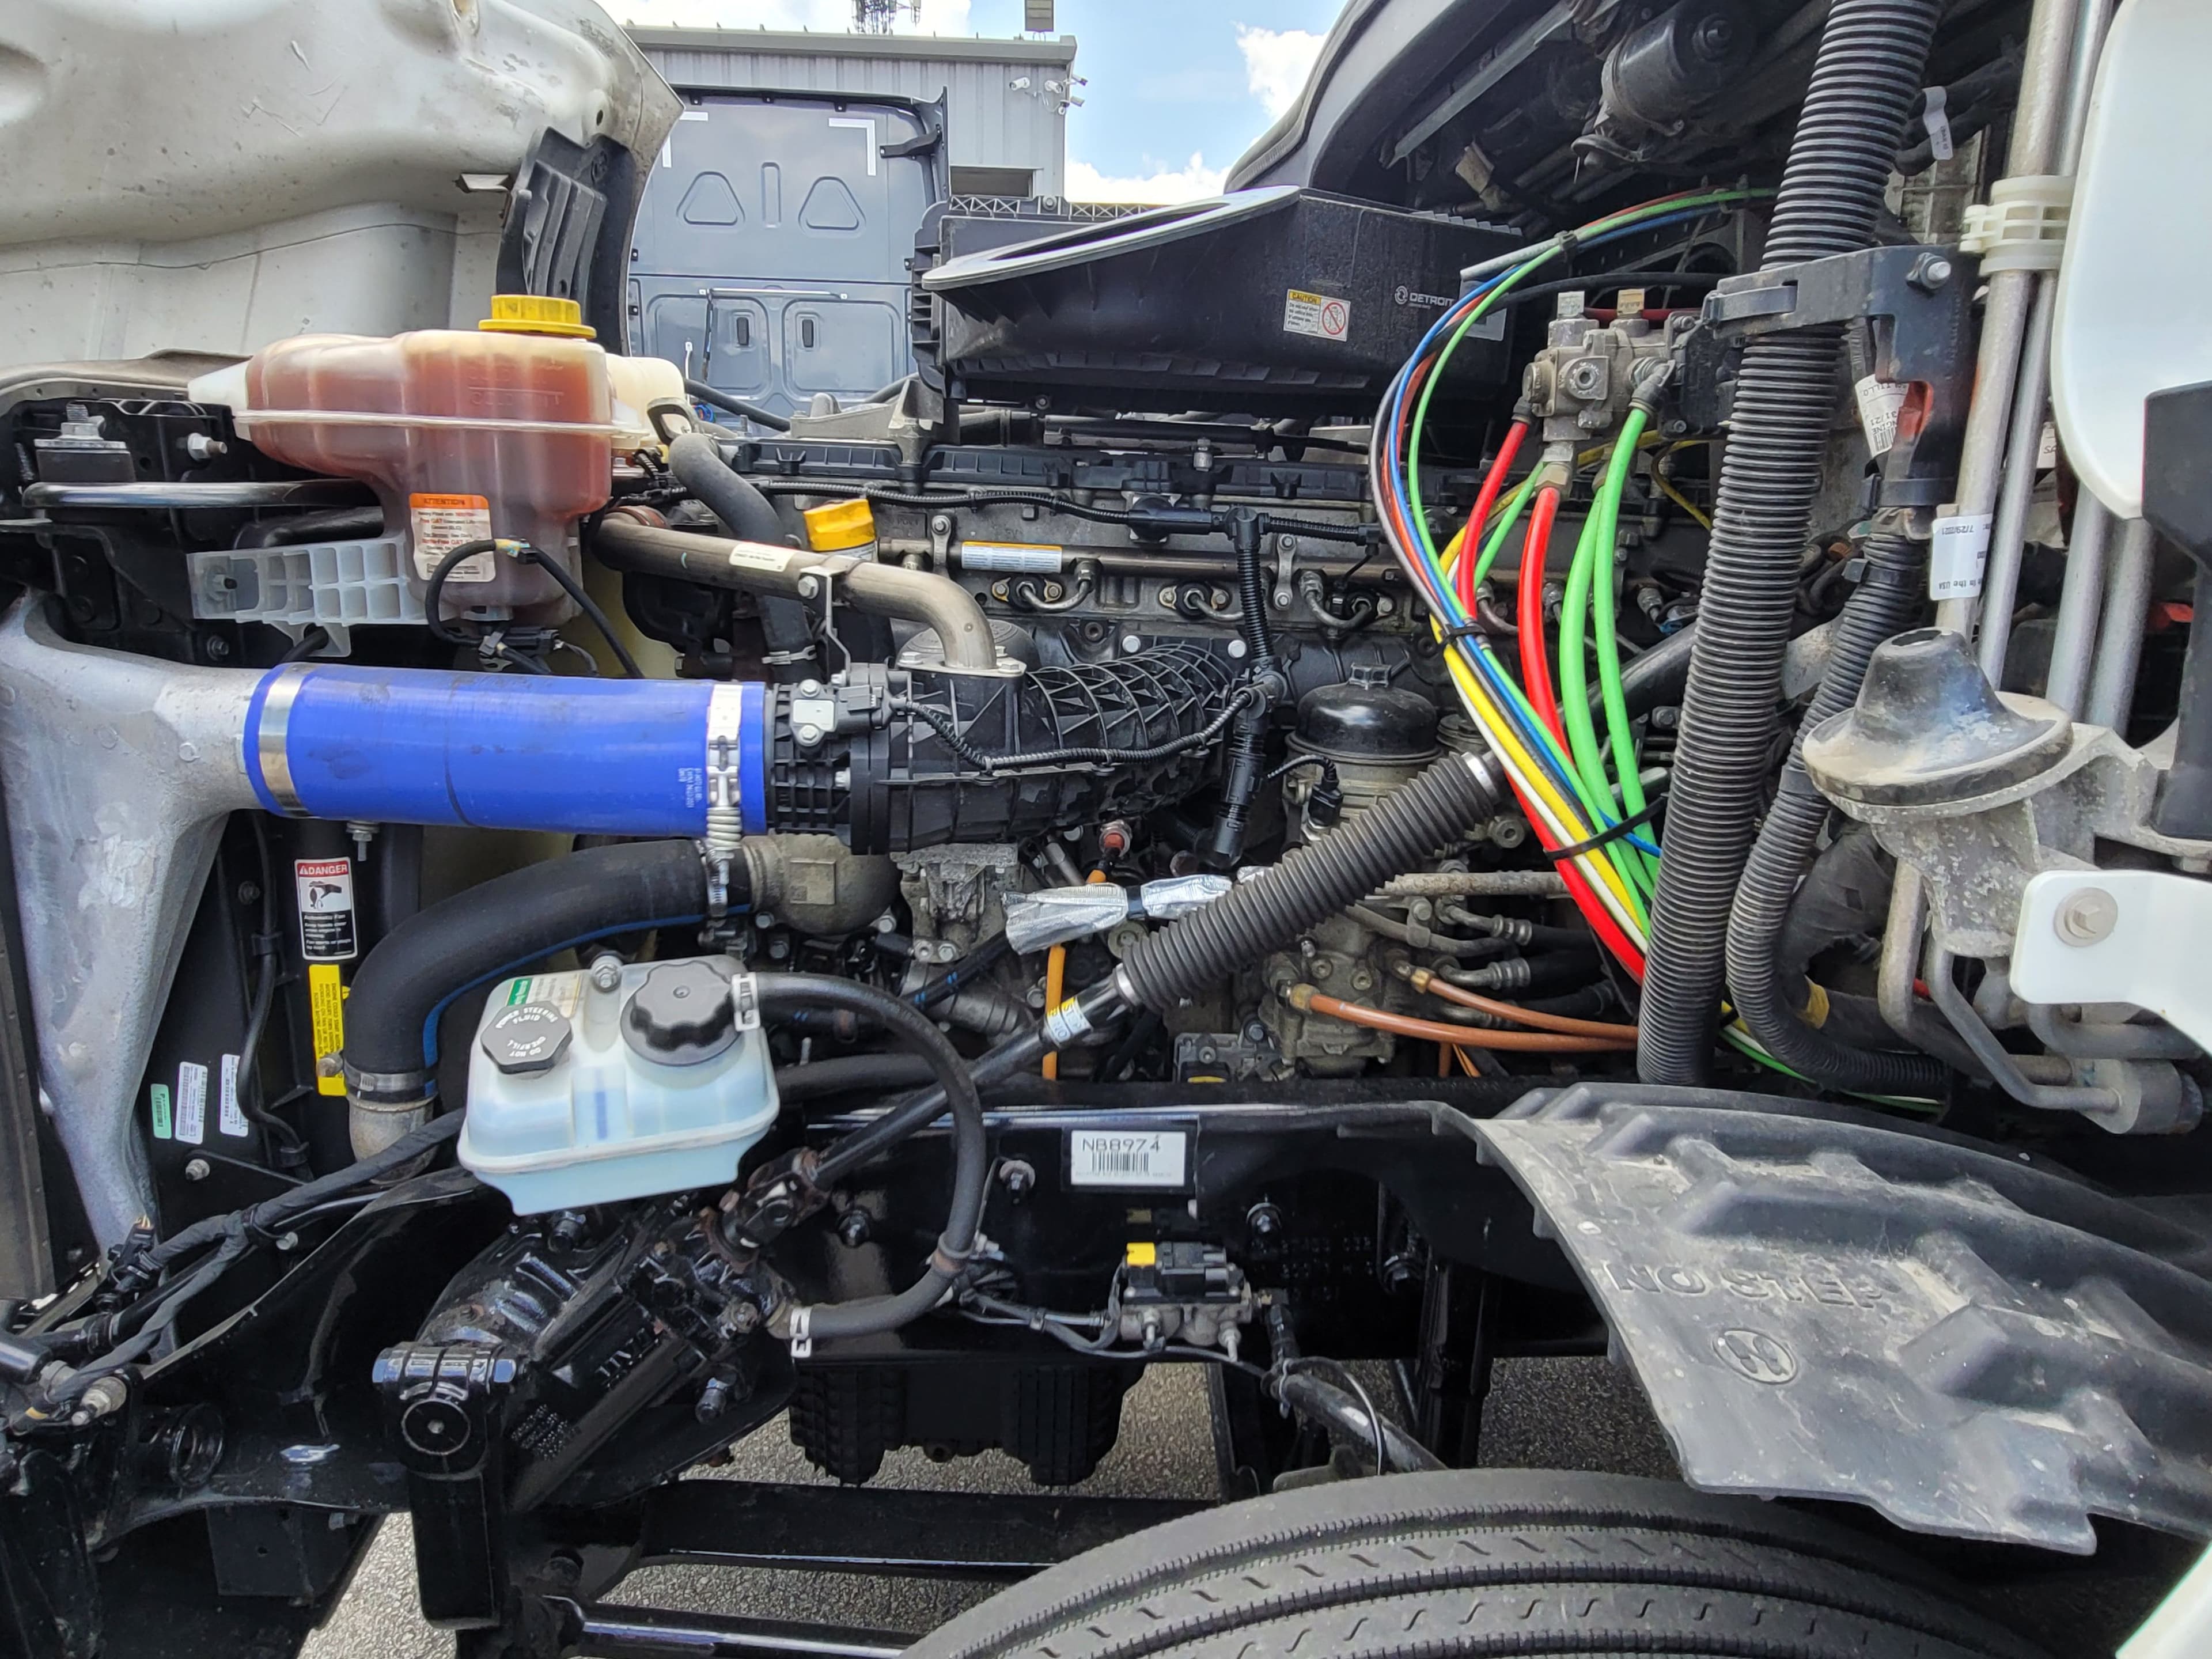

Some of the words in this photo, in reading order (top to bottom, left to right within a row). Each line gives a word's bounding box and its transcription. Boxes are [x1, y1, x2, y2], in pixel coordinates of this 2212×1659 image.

[1292, 293, 1318, 304] CAUTION
[1409, 293, 1455, 306] DETROIT
[1871, 421, 1896, 435] NGINE
[1938, 582, 1950, 590] USA
[308, 864, 347, 875] DANGER
[513, 1014, 541, 1024] FLUID
[524, 1006, 558, 1022] STEERING
[507, 1036, 546, 1050] OVERFILL
[529, 1047, 541, 1056] DO
[1082, 1134, 1161, 1153] NB8974
[1606, 1264, 1707, 1295] NO
[1719, 1269, 1882, 1309] STEP
